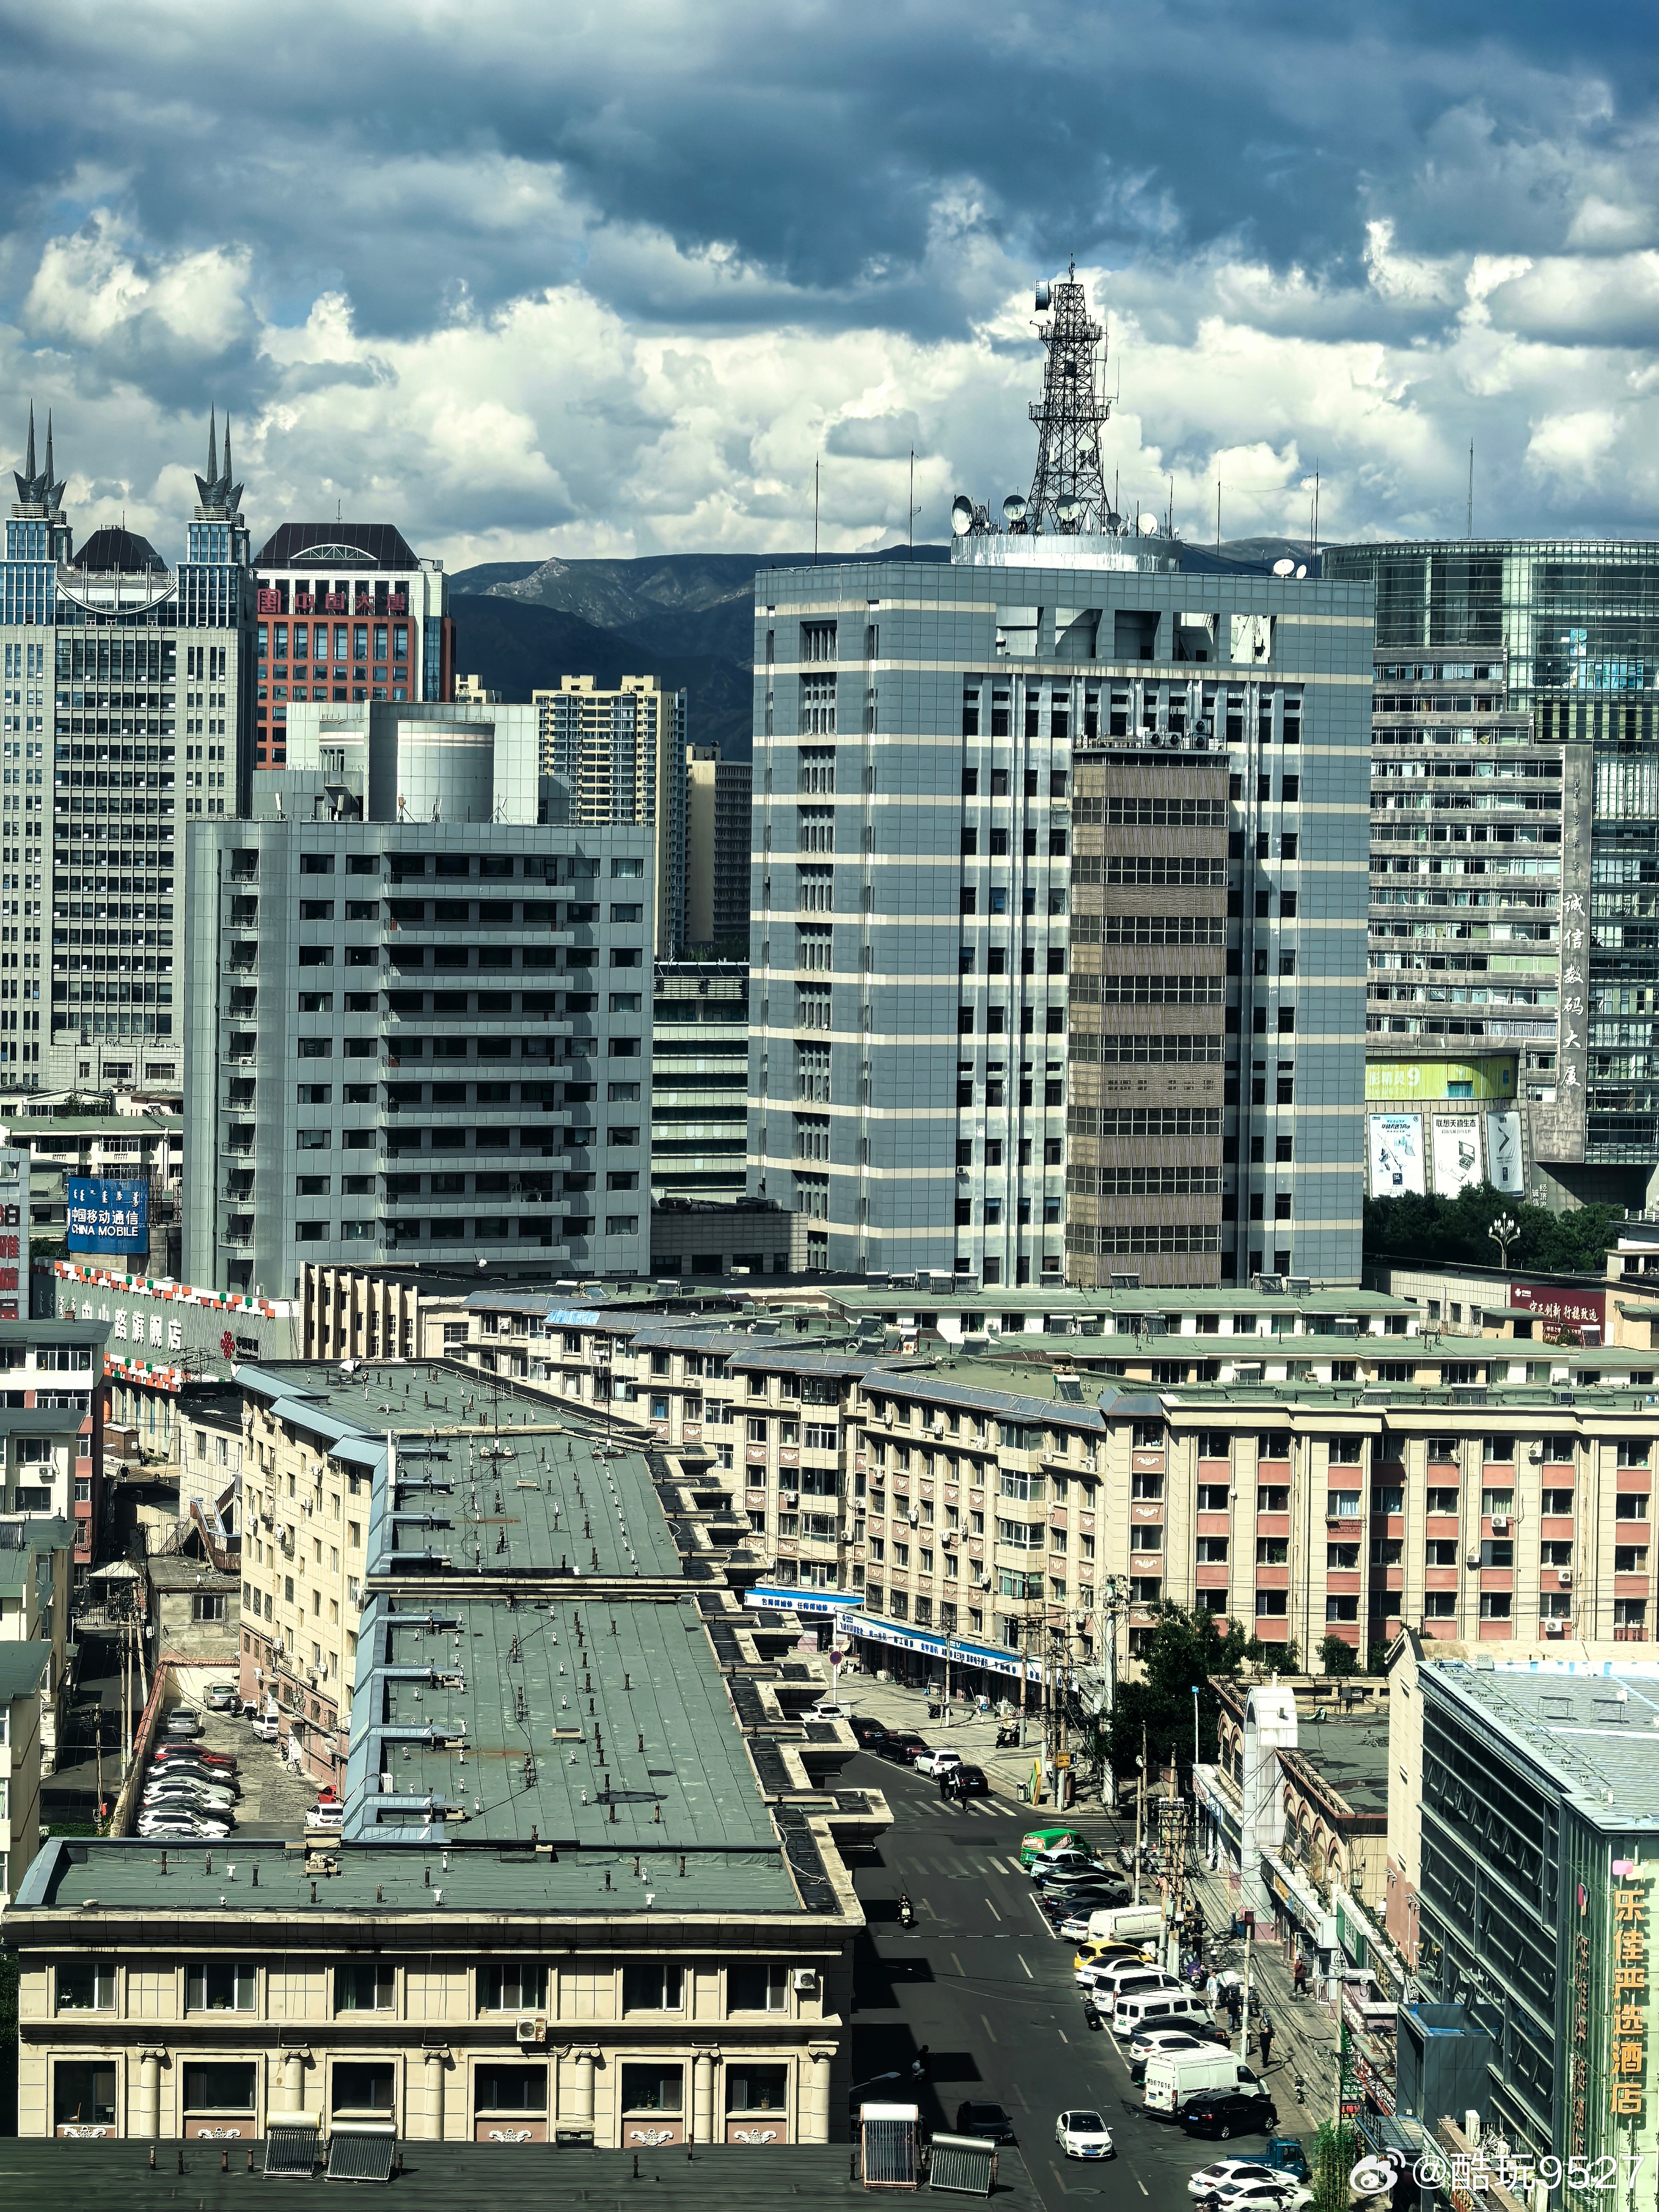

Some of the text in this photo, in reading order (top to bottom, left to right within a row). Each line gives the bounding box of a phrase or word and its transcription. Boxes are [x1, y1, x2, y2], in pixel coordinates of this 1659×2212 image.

[71, 1206, 139, 1225] 中国移动通信
[71, 1224, 138, 1237] CHINA MOBILE
[1529, 1300, 1600, 1322] 守正创新 行稳致远
[1610, 1889, 1645, 2114] 乐佳严选酒店
